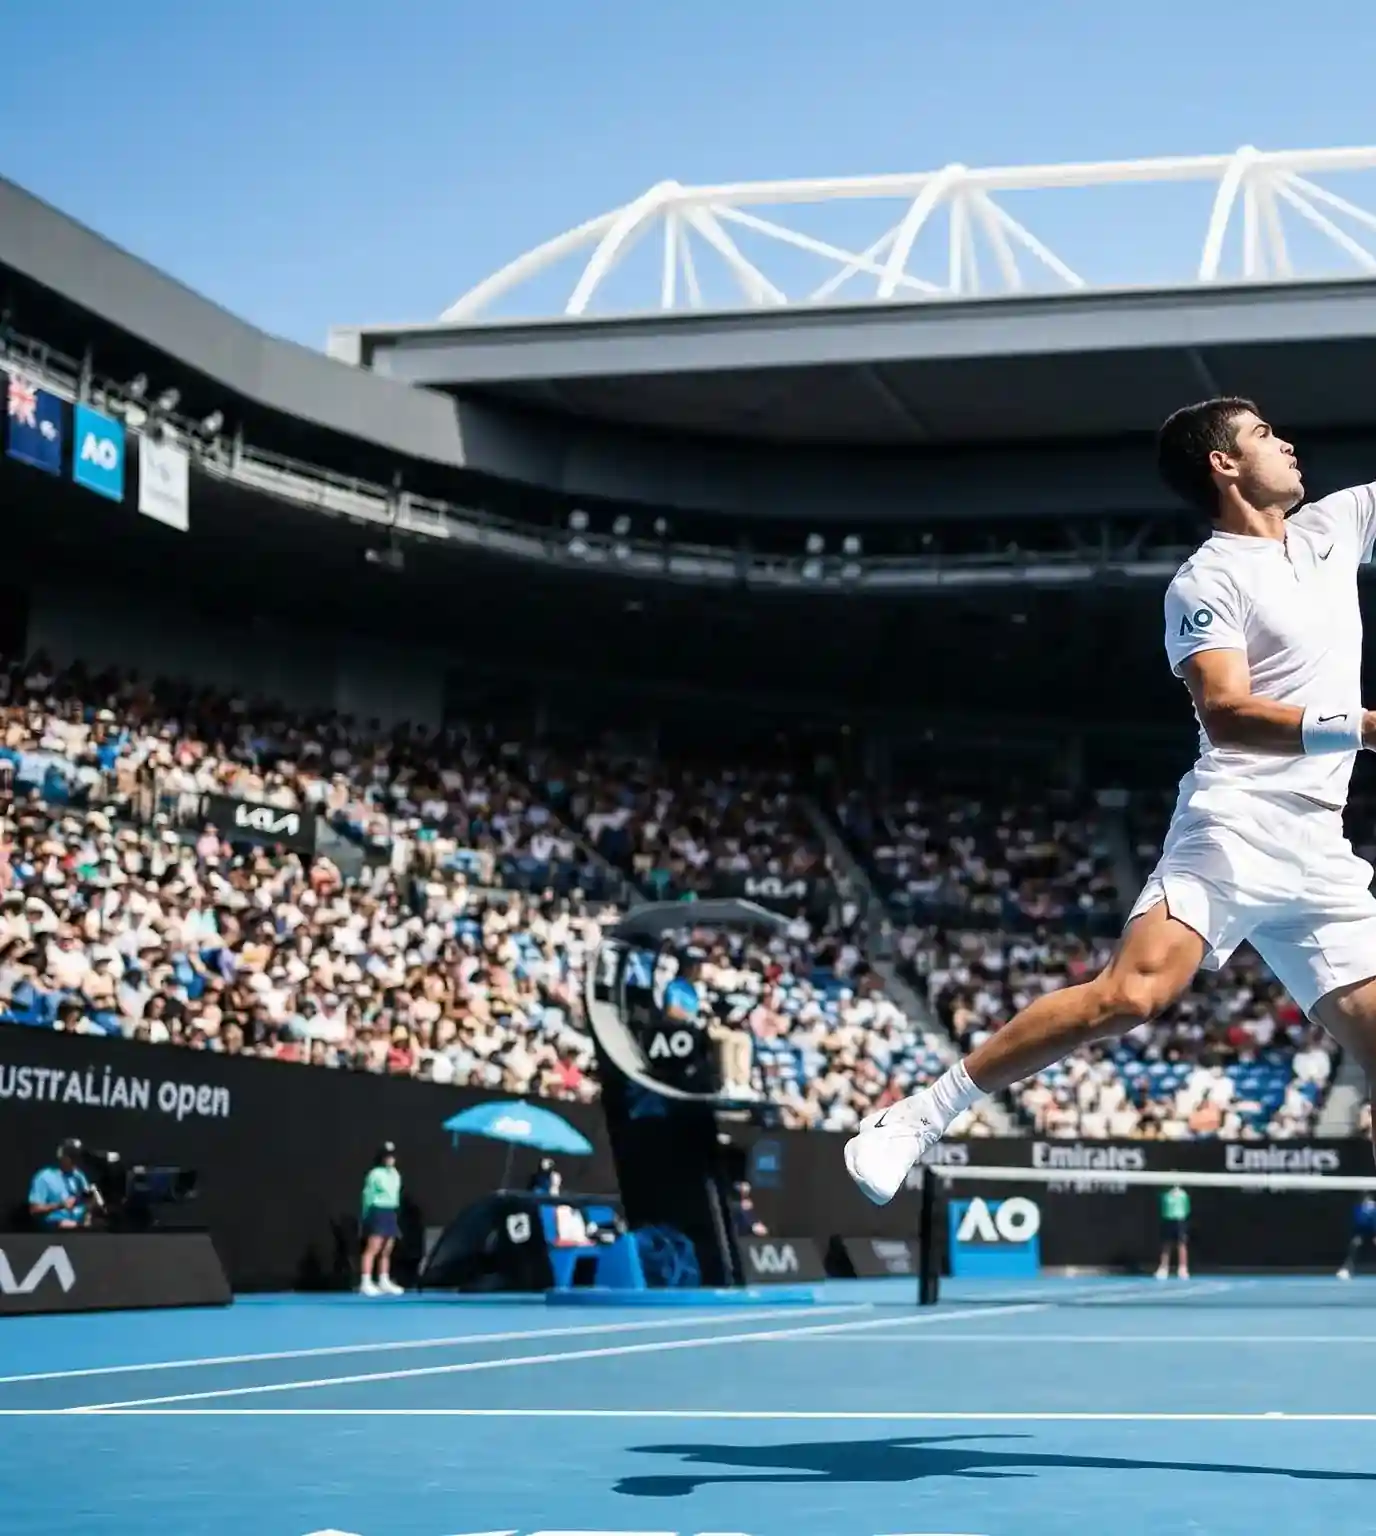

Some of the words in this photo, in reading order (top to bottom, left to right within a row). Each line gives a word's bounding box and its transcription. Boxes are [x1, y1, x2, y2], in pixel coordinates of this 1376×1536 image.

[80, 432, 117, 470] AO
[1179, 609, 1213, 636] AO
[649, 1030, 694, 1058] AO
[158, 1081, 230, 1121] open
[1032, 1142, 1145, 1169] Emirates
[1225, 1143, 1340, 1171] Emirates
[956, 1197, 1041, 1242] AO
